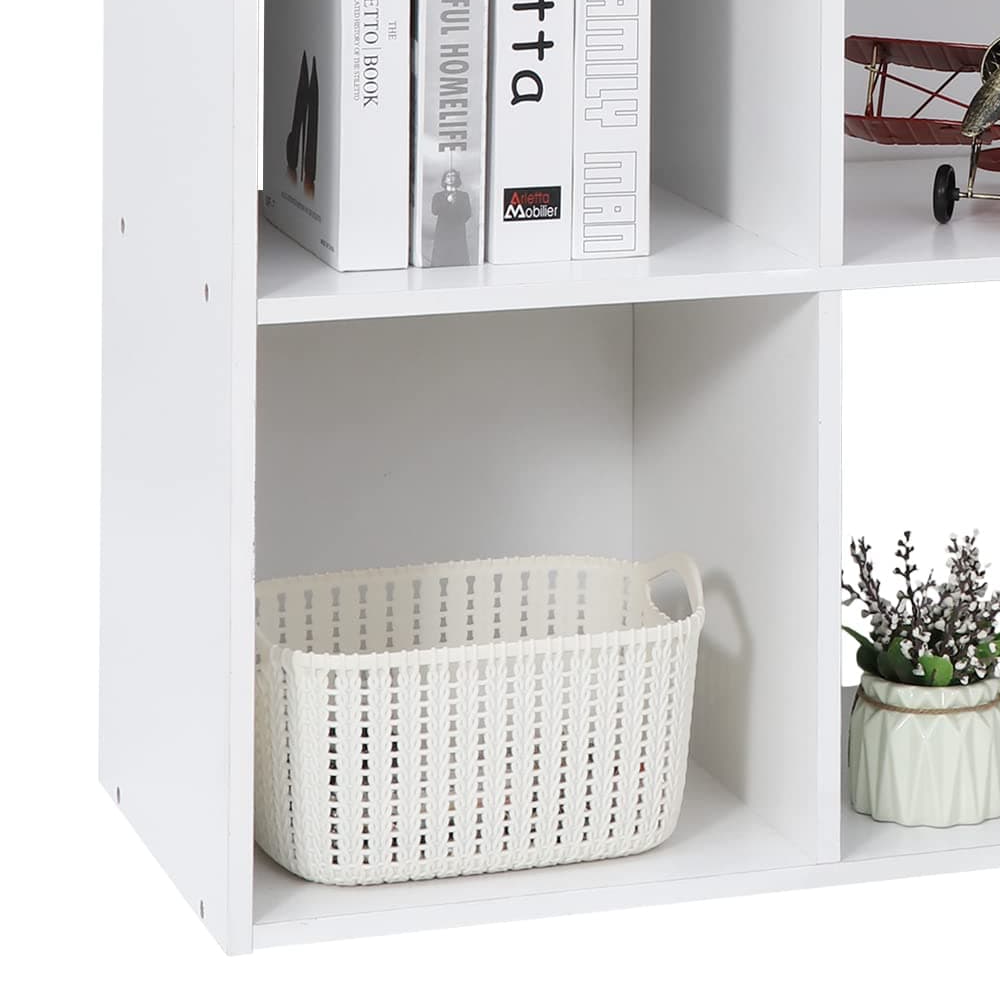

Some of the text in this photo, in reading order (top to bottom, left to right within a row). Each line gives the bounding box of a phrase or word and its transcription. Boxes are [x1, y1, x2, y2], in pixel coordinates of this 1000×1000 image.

[387, 20, 397, 41] THE
[363, 55, 379, 108] BOOK
[438, 43, 469, 153] HOMELIFE
[504, 204, 558, 219] Mobilier
[583, 150, 639, 254] MAN
